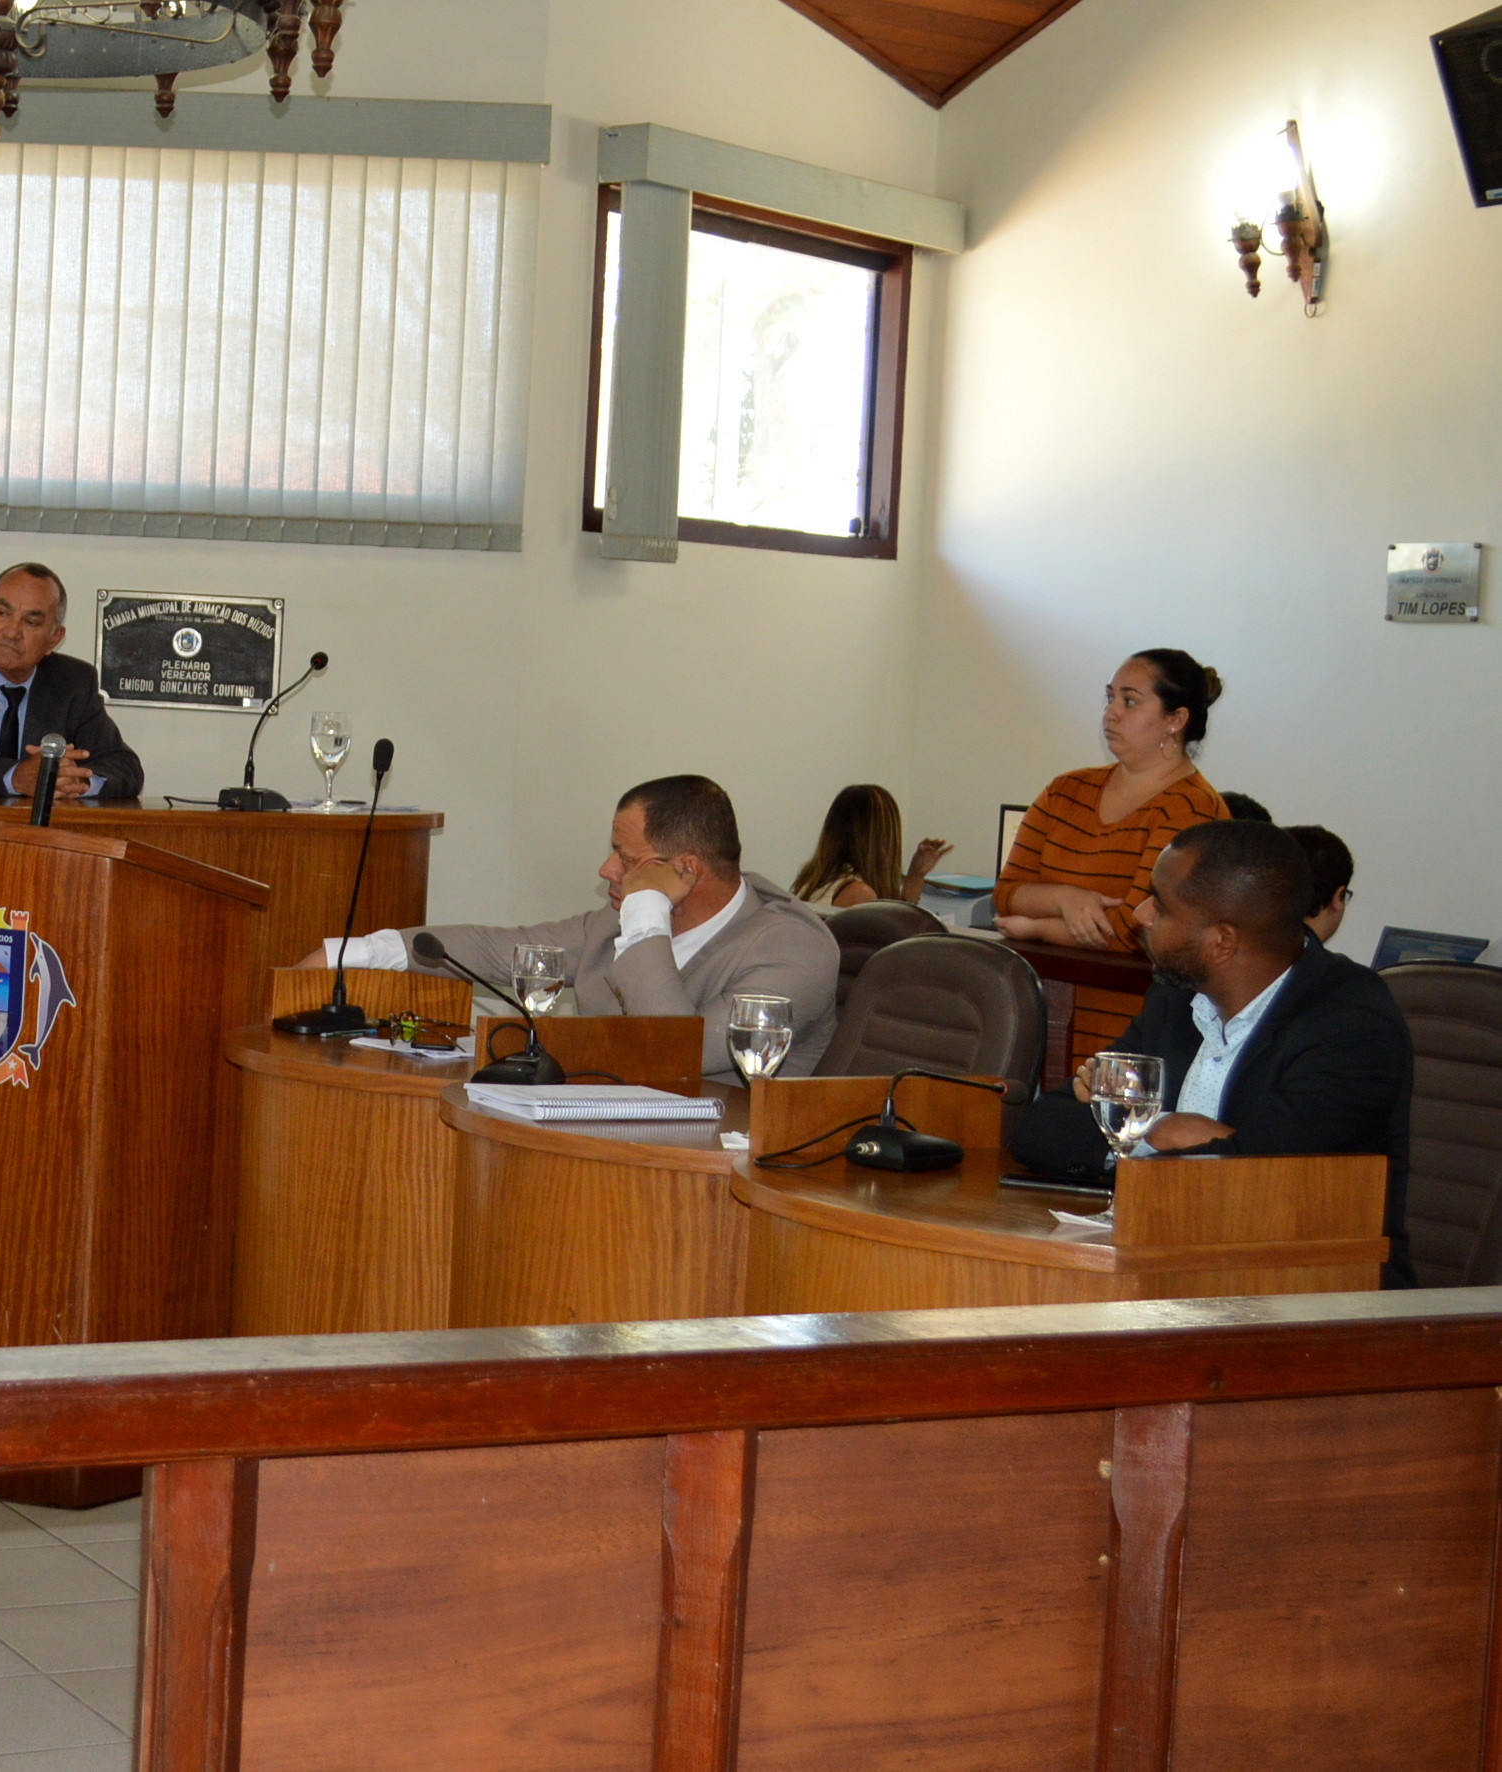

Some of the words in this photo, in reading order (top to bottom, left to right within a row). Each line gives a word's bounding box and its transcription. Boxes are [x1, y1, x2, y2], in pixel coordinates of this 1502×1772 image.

[1398, 601, 1418, 615] TIM
[1421, 601, 1466, 615] LOPES
[103, 608, 138, 631] CÂMARA
[137, 601, 179, 619] MUNICIPAL
[181, 601, 192, 613] DE
[192, 601, 231, 620] ARMAÇÃO
[230, 609, 249, 626] DOS
[247, 615, 276, 639] BÚZIOS
[162, 659, 211, 671] PLENÁRIO
[161, 669, 211, 681] VEREADOR
[119, 677, 154, 692] EMÍGDIO
[213, 683, 255, 698] COUTINHO
